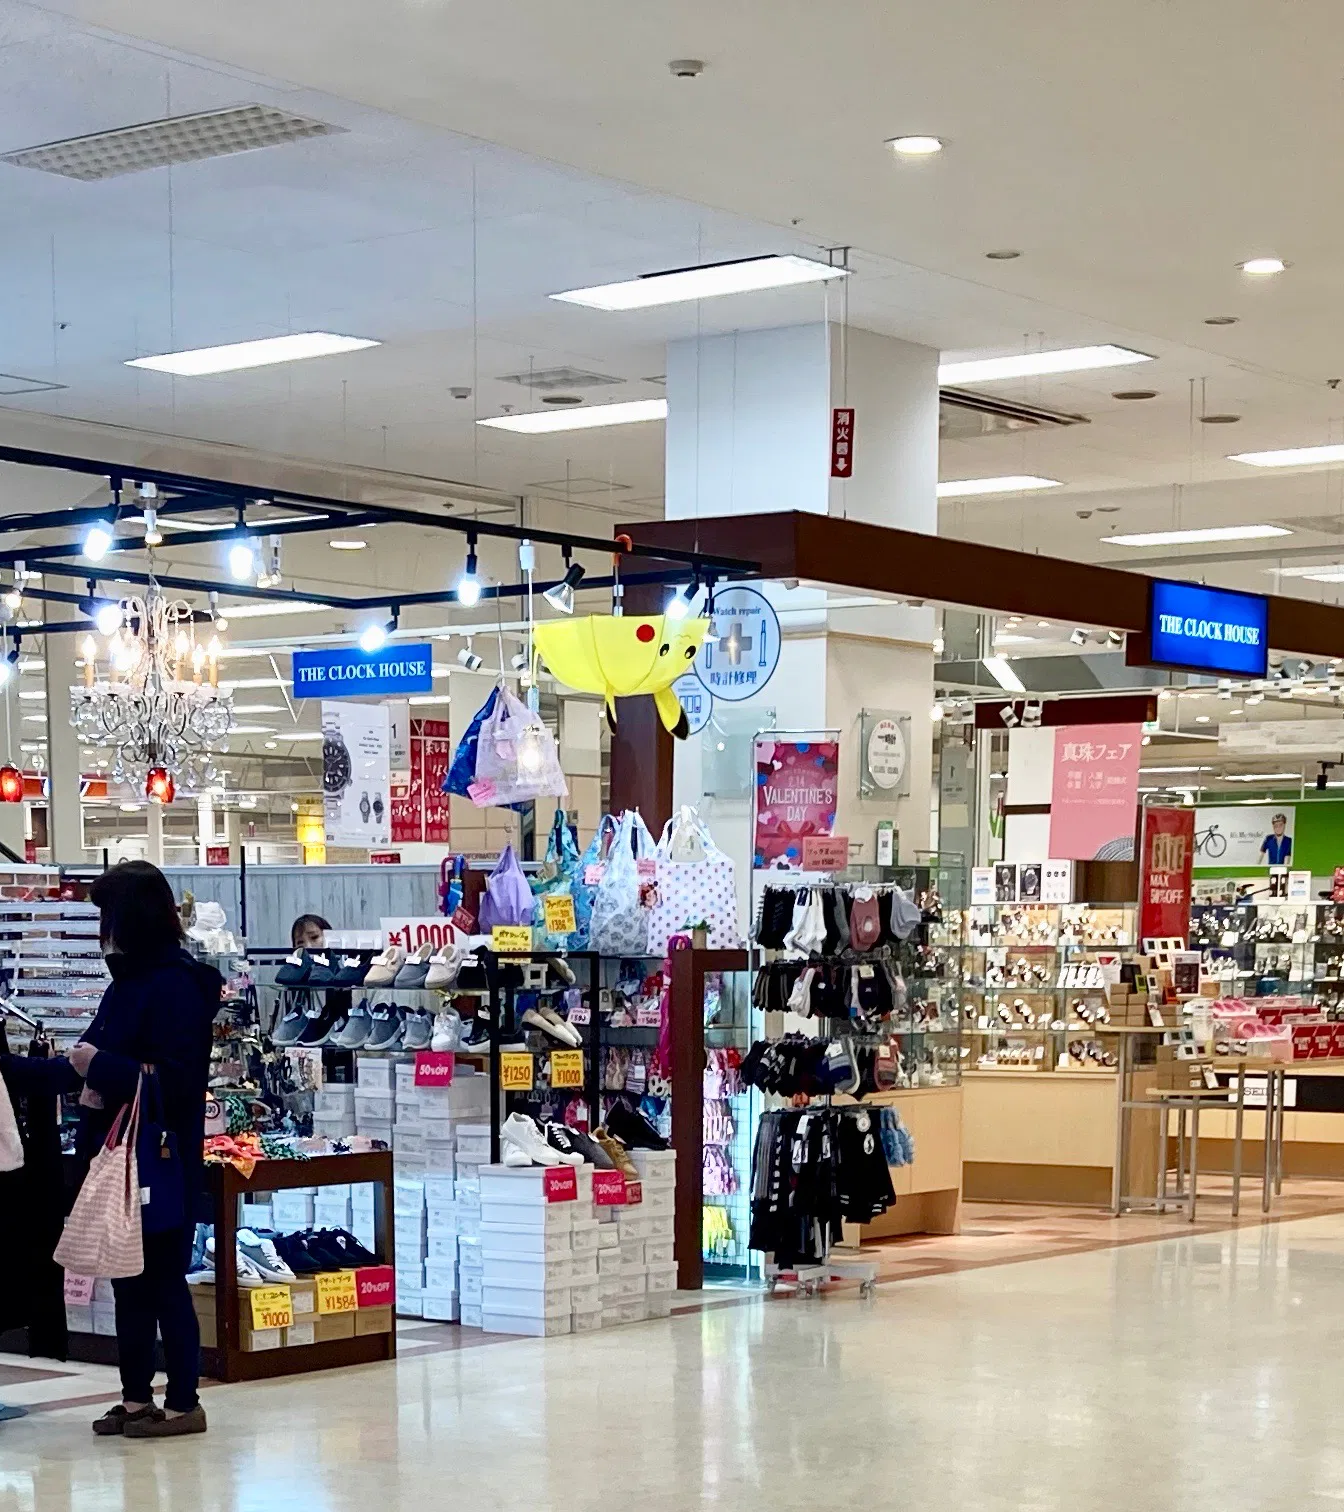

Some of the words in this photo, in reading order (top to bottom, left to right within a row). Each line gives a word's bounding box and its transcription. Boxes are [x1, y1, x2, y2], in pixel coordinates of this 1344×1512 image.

[738, 606, 761, 616] repair
[1159, 614, 1183, 635] THE
[1184, 618, 1223, 640] CLOCK
[1224, 623, 1260, 645] HOUSE
[297, 666, 326, 682] THE
[328, 663, 376, 681] CLOCK
[378, 660, 426, 678] HOUSE
[710, 670, 757, 686] 時計修理
[1060, 742, 1133, 762] 真珠フェア
[786, 806, 808, 822] DAY
[1150, 874, 1170, 887] MAX
[503, 1065, 530, 1082] ¥1250
[361, 1281, 391, 1294] 20%OFF
